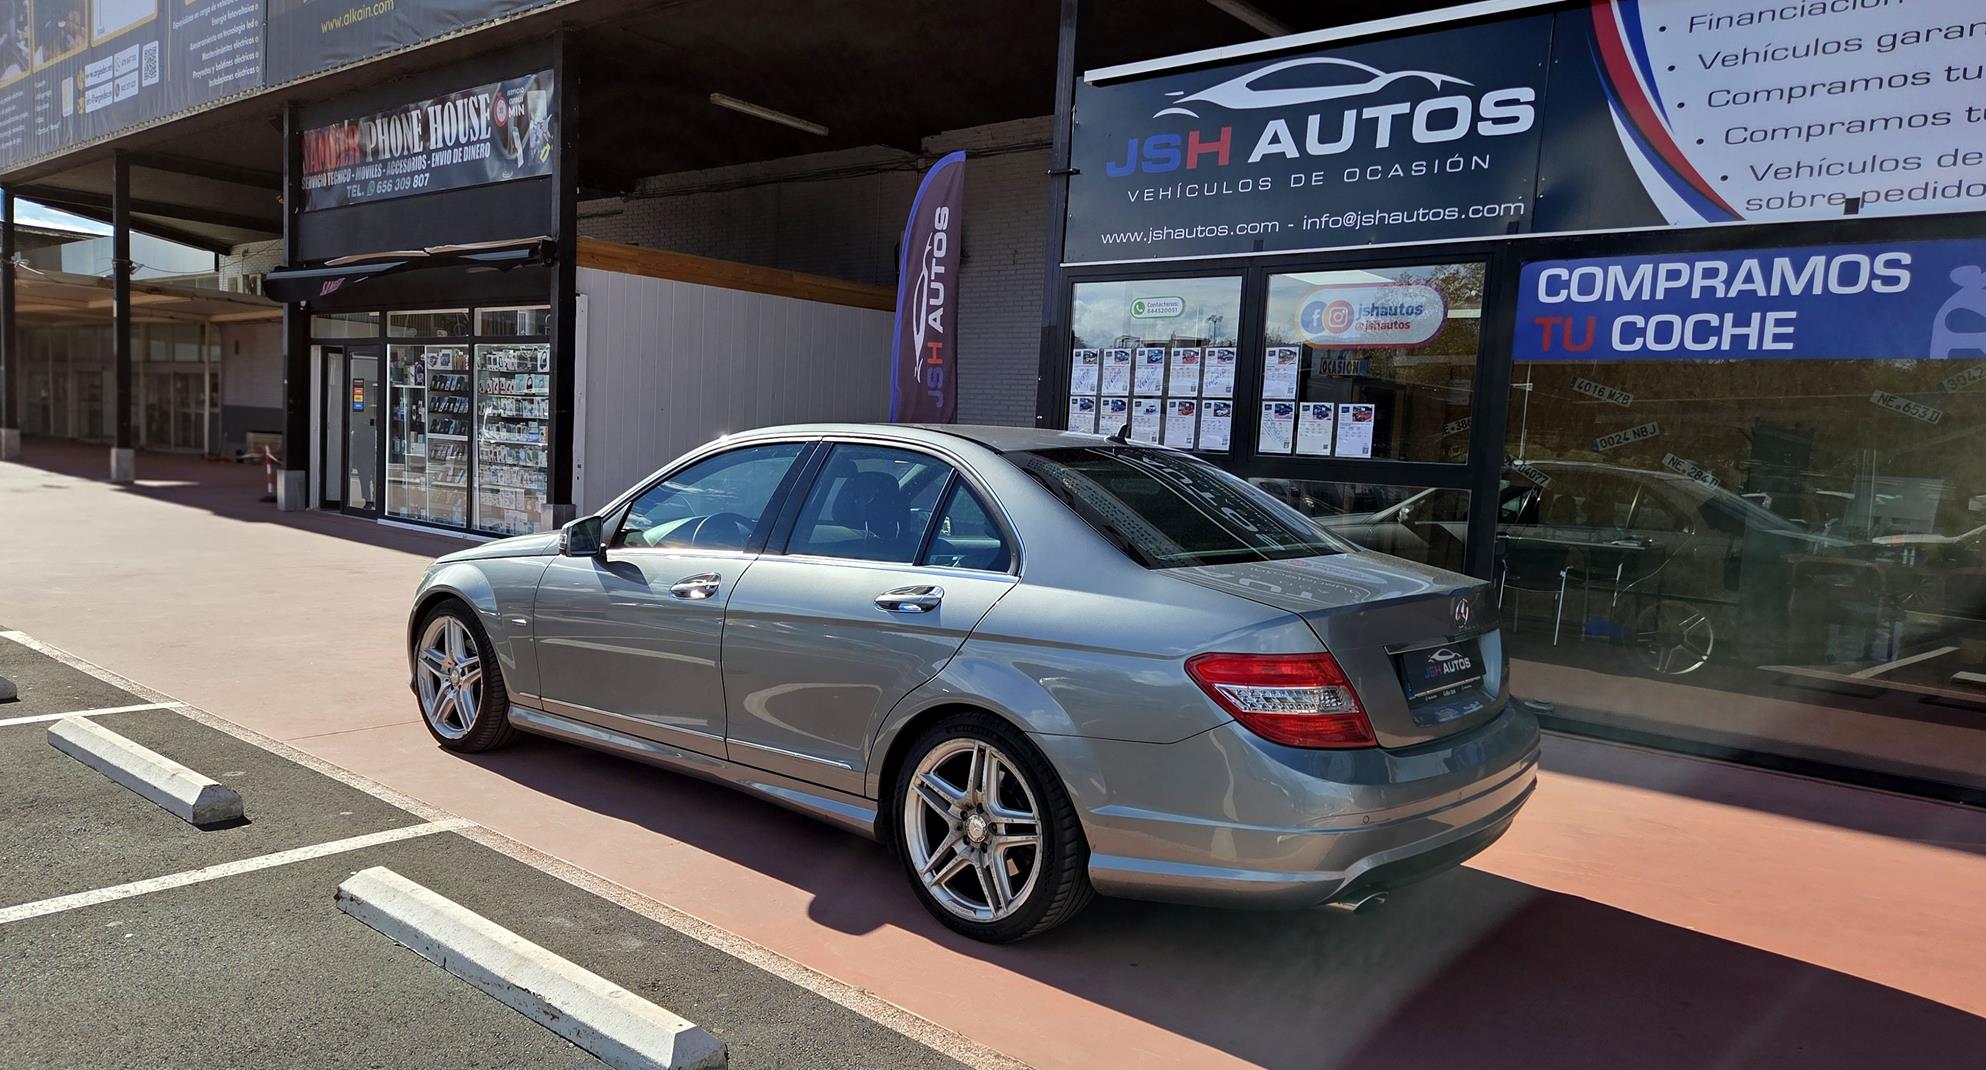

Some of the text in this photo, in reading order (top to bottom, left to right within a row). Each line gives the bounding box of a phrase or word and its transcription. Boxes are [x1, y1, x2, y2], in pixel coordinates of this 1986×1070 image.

[320, 0, 395, 33] www.alkain.com
[1697, 37, 1863, 71] Vehículos
[1706, 64, 1984, 109] Compramos tu
[363, 109, 424, 163] PHONE
[427, 93, 492, 151] HOUSE
[1105, 86, 1536, 178] JSH AUTOS
[1723, 105, 1986, 146] Compramos t
[431, 149, 452, 168] ENVIO
[452, 147, 462, 163] DE
[463, 142, 491, 161] DINERO
[1748, 148, 1984, 182] Vehículos de
[346, 183, 365, 199] TEL.
[376, 179, 393, 194] 656
[412, 173, 430, 188] 807
[1127, 152, 1491, 203] VEHÍCULOS DE OCASIÓN
[1744, 187, 1846, 213] sobre
[1100, 218, 1280, 244] www.jshautos.com
[1302, 200, 1525, 231] info@jshautos.com
[927, 205, 950, 334] AUTOS
[1536, 251, 1912, 304] COMPRAMOS
[1357, 302, 1424, 320] jshautos
[1534, 310, 1798, 352] TU COCHE
[1576, 378, 1605, 397] 4016
[1443, 656, 1472, 675] AUTOS
